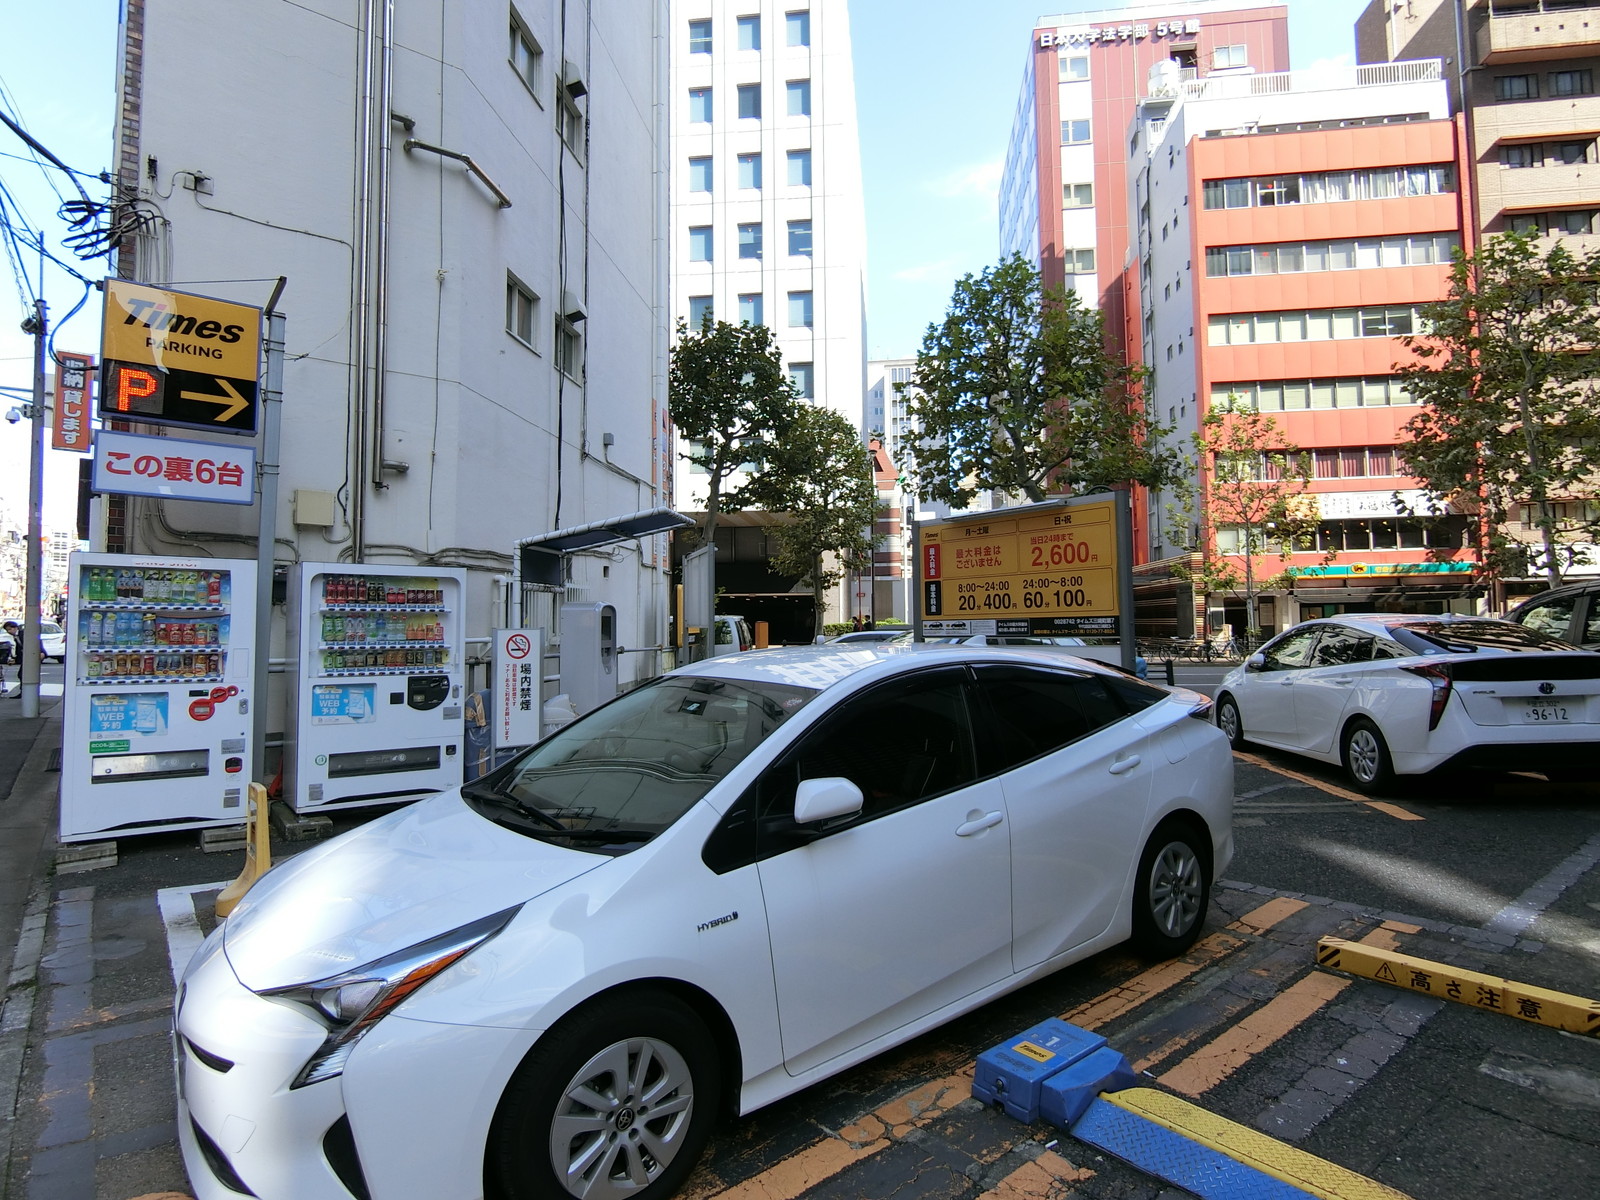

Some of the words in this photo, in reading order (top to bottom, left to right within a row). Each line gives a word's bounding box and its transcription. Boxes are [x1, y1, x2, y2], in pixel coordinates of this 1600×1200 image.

[1039, 22, 1149, 47] 日本大学法学部
[1157, 18, 1201, 37] 5号館
[123, 297, 245, 344] Times
[145, 336, 224, 361] PARKING
[116, 367, 157, 412] P
[105, 450, 245, 488] この裏6台
[1030, 532, 1074, 545] 当日24時まで
[955, 545, 1001, 559] 最大料金は
[956, 557, 1002, 569] ございません
[520, 663, 531, 711] 場内禁煙
[98, 713, 125, 721] WEB
[1532, 708, 1568, 721] 96-12
[697, 913, 733, 932] HYBRID
[1409, 969, 1542, 1021] 高さ注意
[1019, 1044, 1048, 1059] Times
